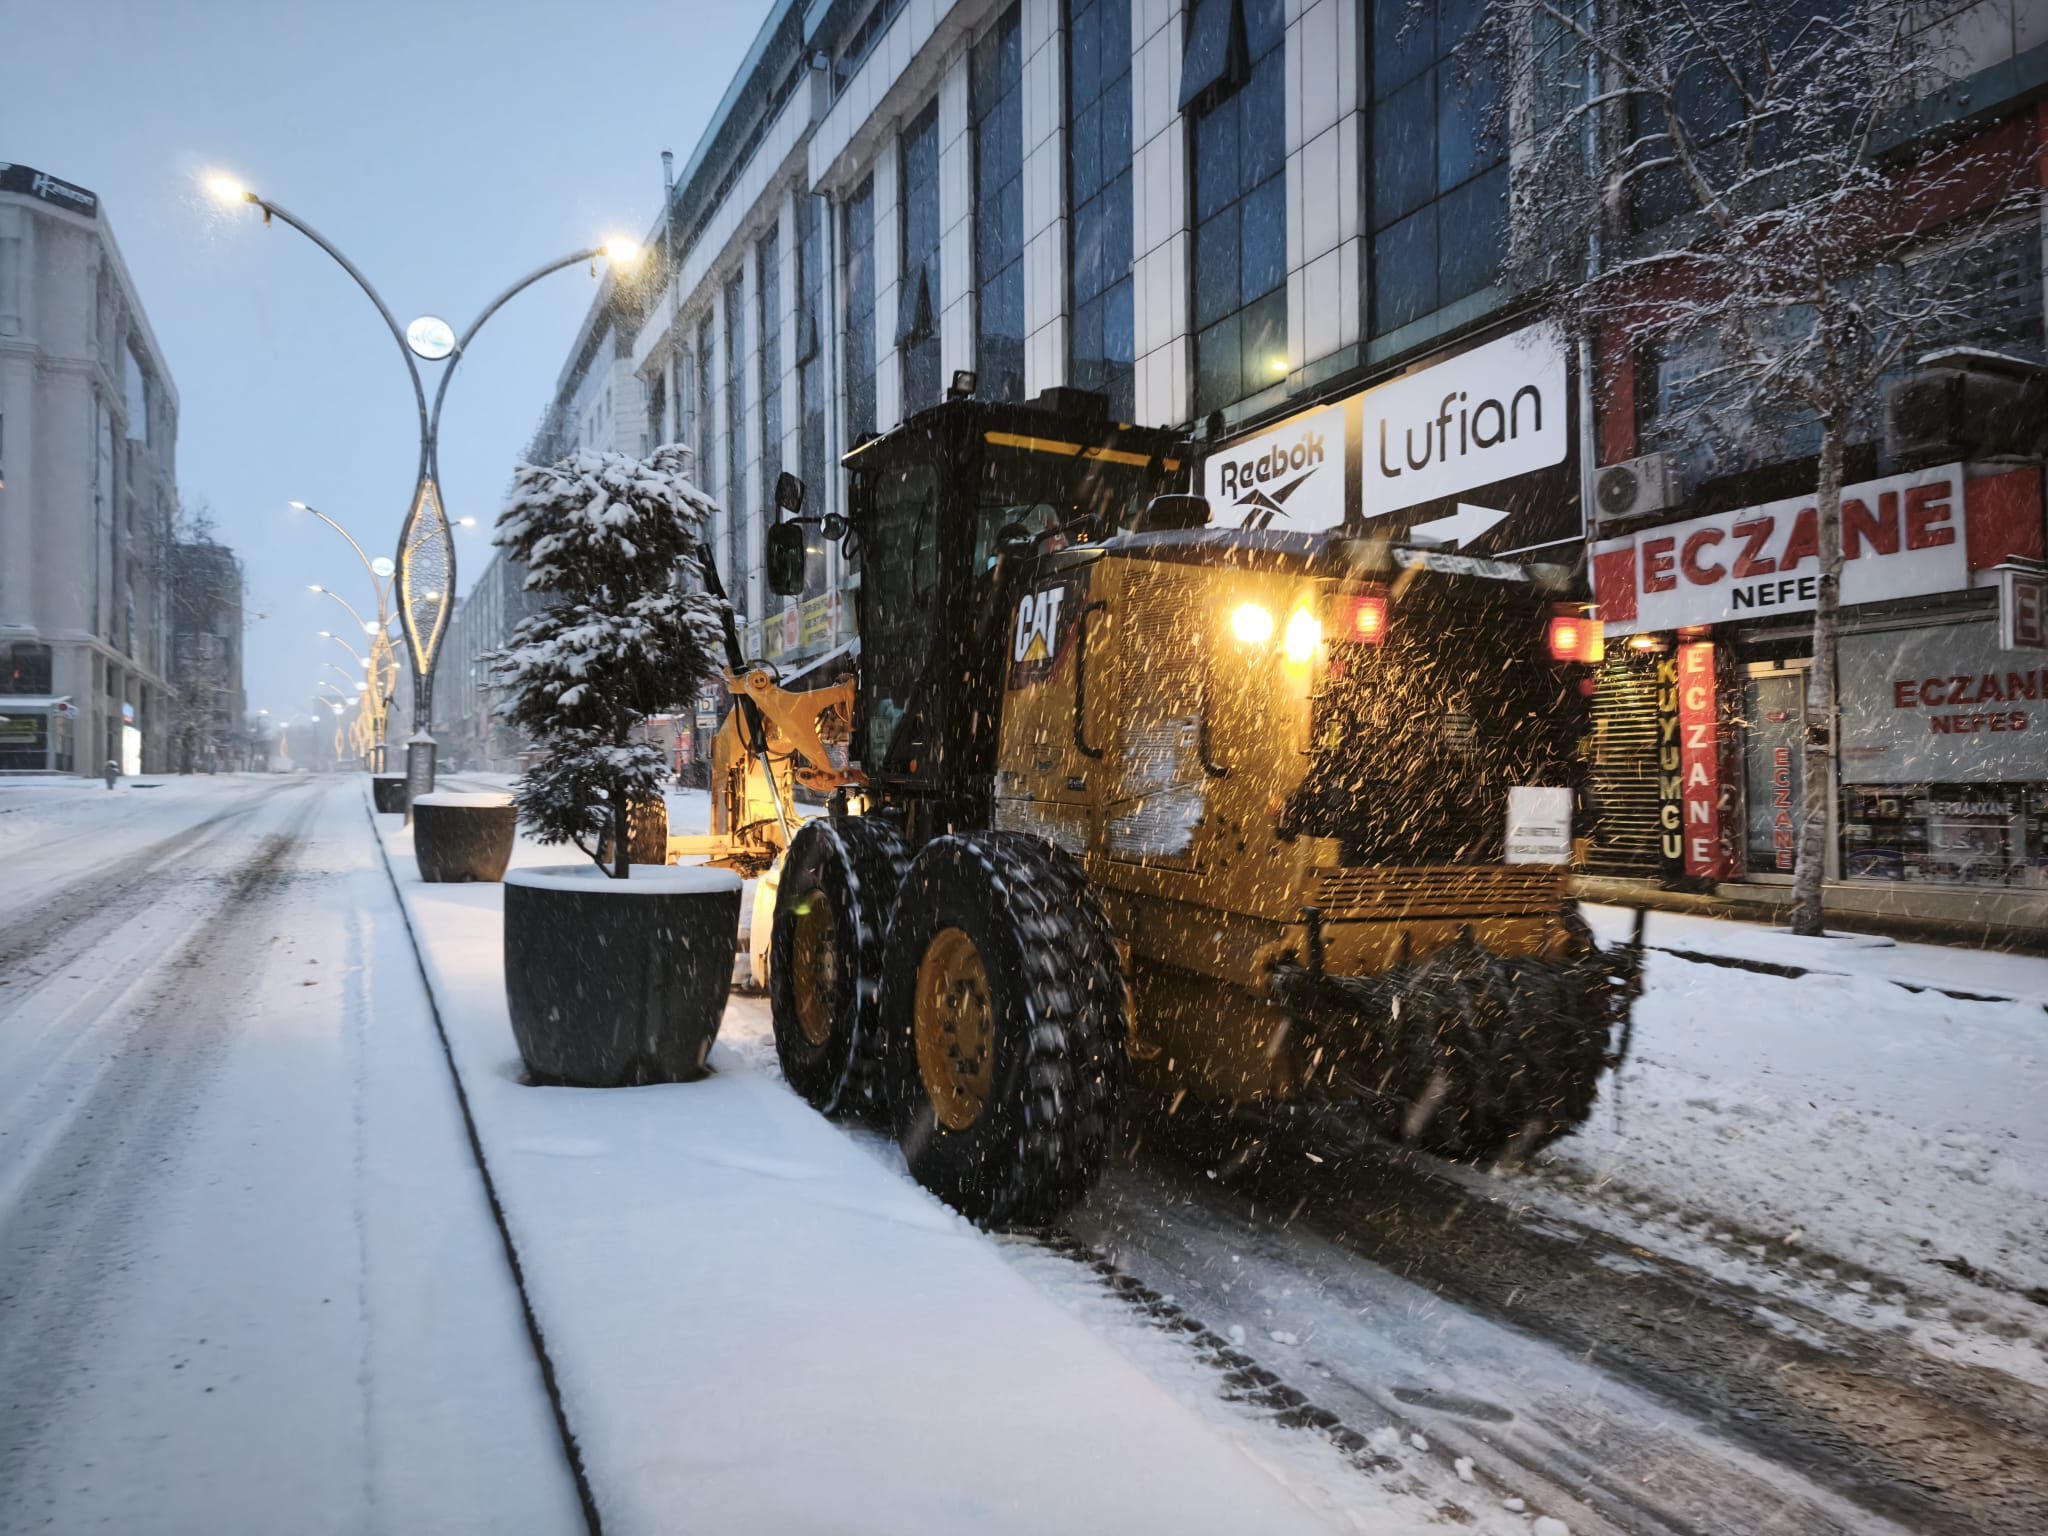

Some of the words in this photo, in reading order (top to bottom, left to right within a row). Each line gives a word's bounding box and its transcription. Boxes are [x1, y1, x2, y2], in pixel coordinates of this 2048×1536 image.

[1221, 431, 1325, 500] Reebok
[1379, 384, 1543, 479] Lufian
[1642, 480, 1956, 595] ECZANE
[1014, 586, 1065, 664] CAT
[1732, 576, 1819, 611] NEFE
[1893, 669, 2048, 709] ECZAN
[1931, 710, 2028, 735] NEFES
[1657, 658, 1683, 860] KUYUMCU
[1685, 649, 1713, 863] ECZANE
[1773, 747, 1793, 870] ECZANE
